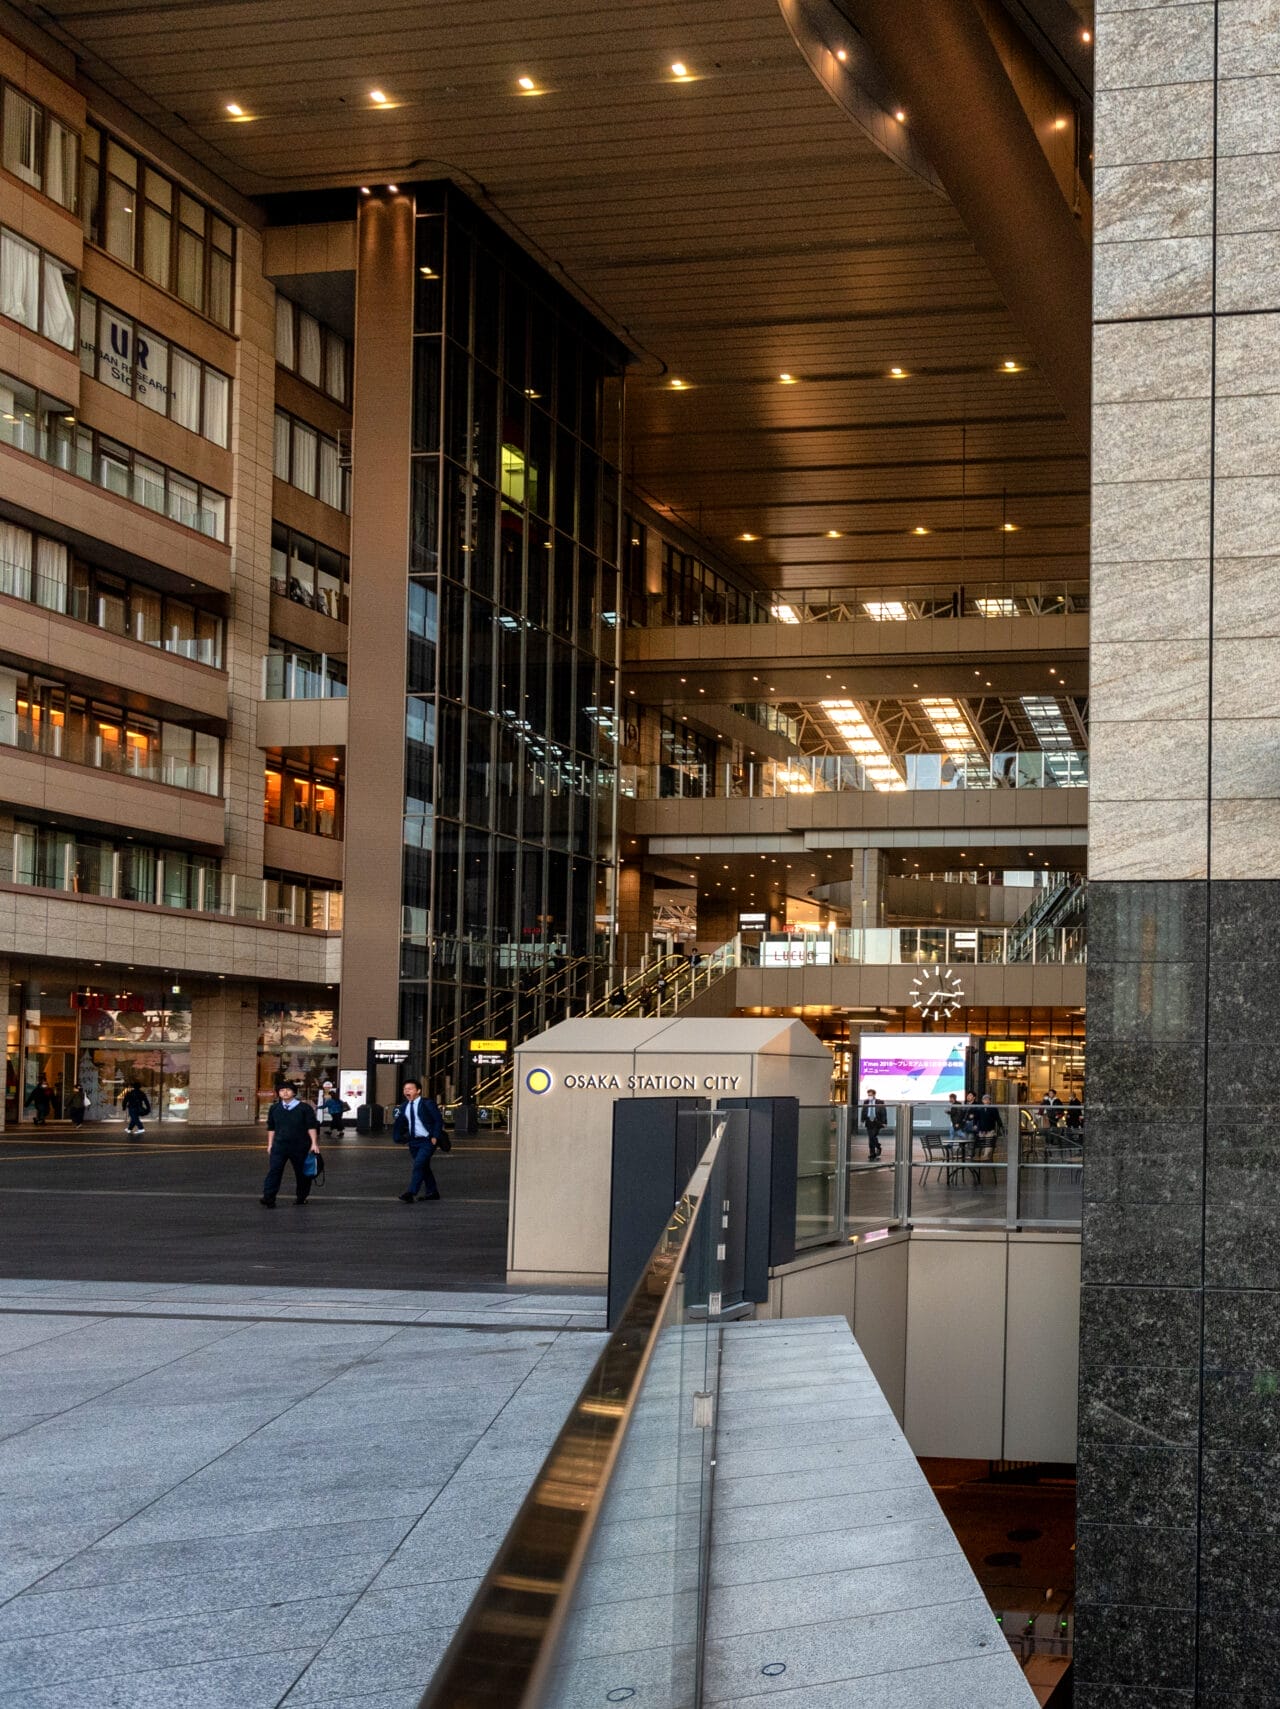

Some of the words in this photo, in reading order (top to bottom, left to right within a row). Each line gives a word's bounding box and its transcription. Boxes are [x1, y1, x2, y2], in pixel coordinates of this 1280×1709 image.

[80, 339, 118, 367] URAN
[111, 322, 148, 370] UR
[111, 366, 147, 394] Stoe
[564, 1074, 619, 1089] OSAKA
[627, 1075, 696, 1090] STATION
[703, 1076, 740, 1091] CITY
